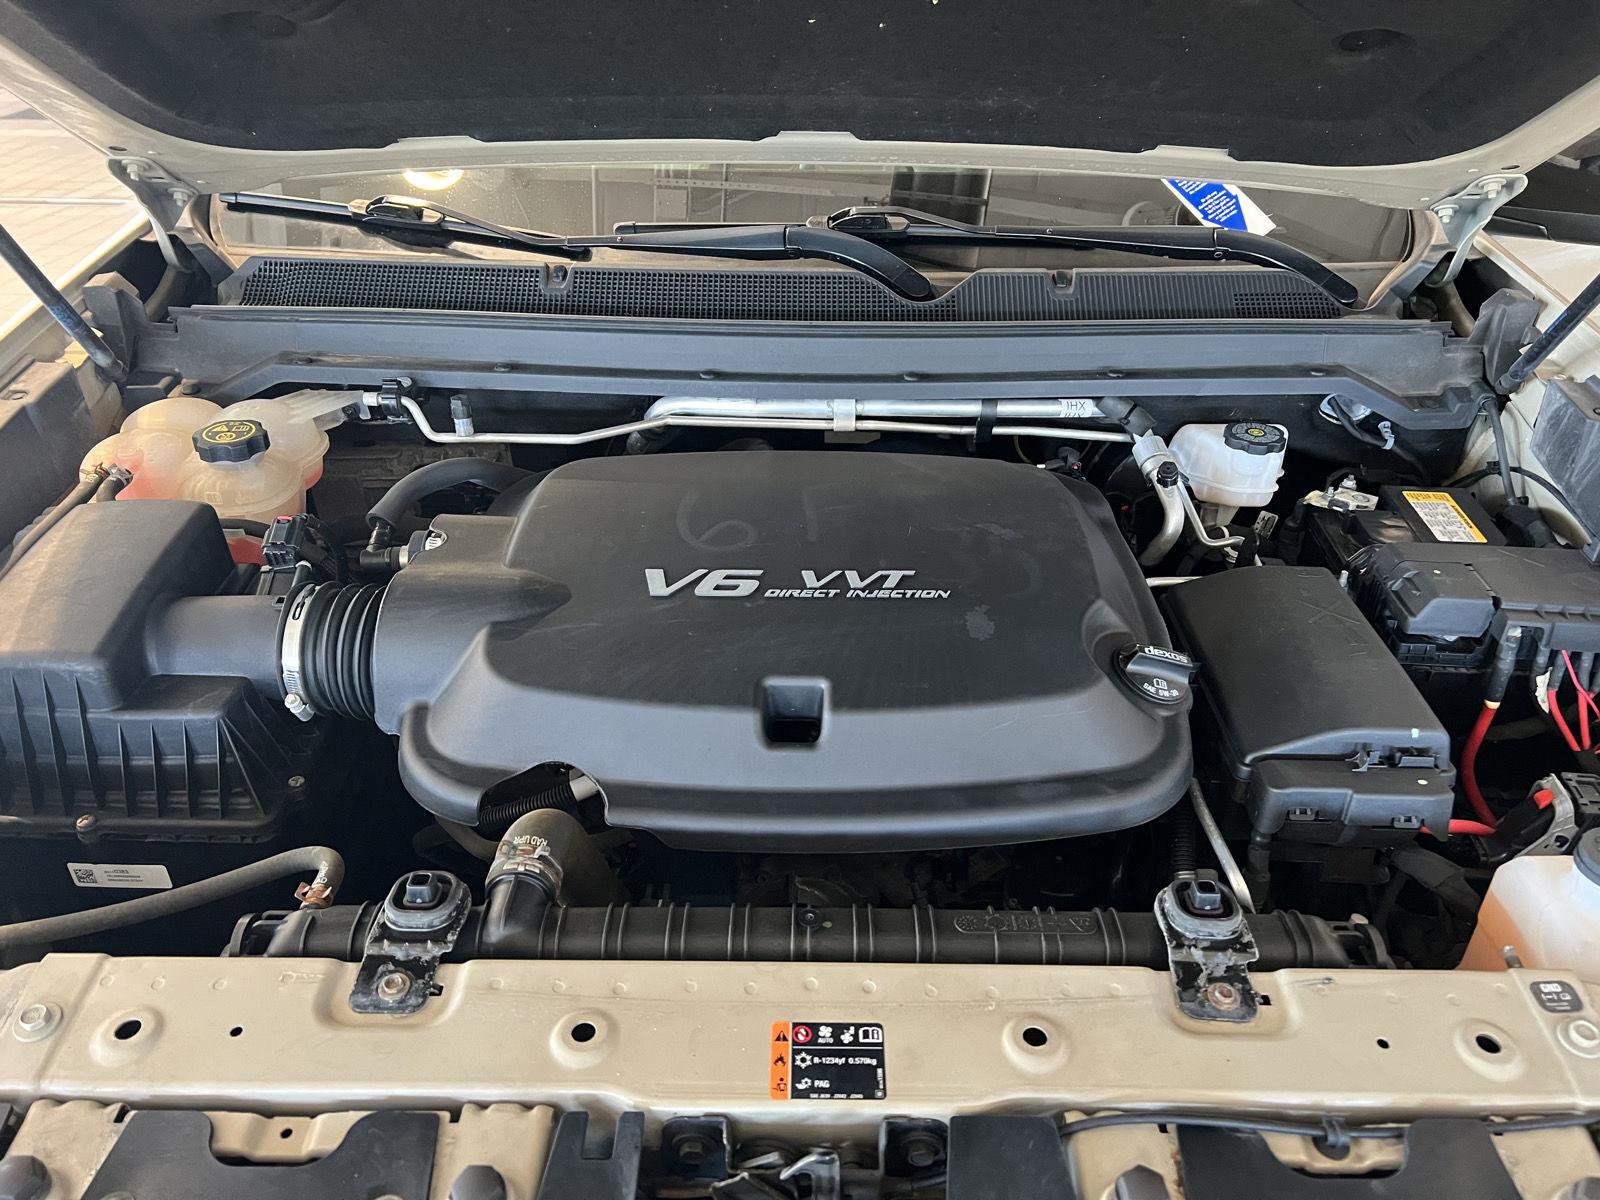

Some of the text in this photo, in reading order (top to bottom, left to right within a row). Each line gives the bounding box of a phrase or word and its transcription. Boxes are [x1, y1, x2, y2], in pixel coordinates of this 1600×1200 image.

[644, 568, 916, 597] V6 VVT
[764, 589, 951, 599] DIRECT INJECTION
[1144, 646, 1188, 663] dexos
[814, 1080, 830, 1089] PAG
